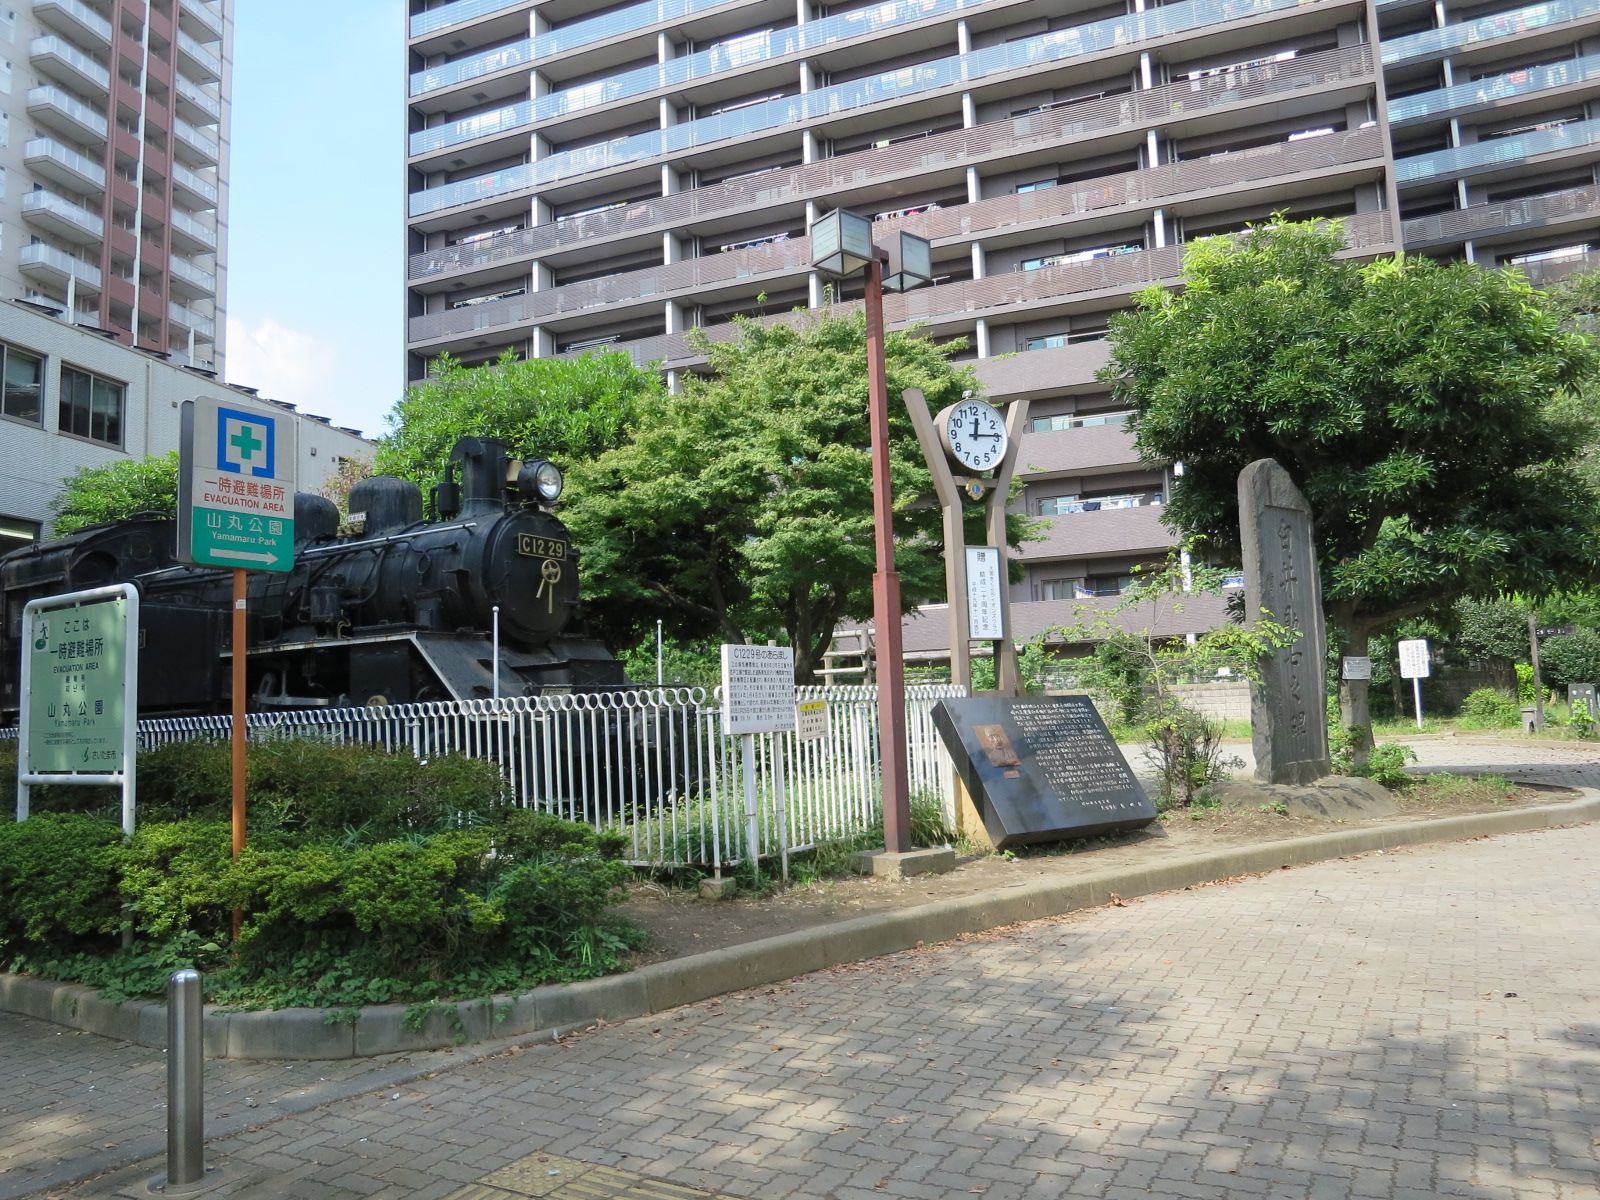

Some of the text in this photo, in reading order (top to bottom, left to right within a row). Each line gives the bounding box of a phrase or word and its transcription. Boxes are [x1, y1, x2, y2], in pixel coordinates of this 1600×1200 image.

[959, 409, 967, 419] 11
[968, 407, 978, 416] 12
[952, 418, 962, 428] 10
[990, 420, 996, 429] 2
[951, 430, 957, 439] 9
[994, 433, 1000, 442] 3
[955, 442, 961, 452] 8
[991, 445, 996, 454] 4
[964, 452, 970, 461] 7
[974, 456, 980, 465] 6
[984, 453, 990, 462] 5
[205, 477, 285, 501] 一時避難場所
[204, 493, 285, 513] EVACUATION AREA
[207, 512, 282, 535] 山丸公園
[212, 531, 277, 546] Yamamaru Park
[64, 618, 90, 633] ここは
[50, 637, 104, 659] 一時避難場所
[53, 662, 99, 674] EVACUATION AREA
[48, 700, 104, 718] 山丸公園
